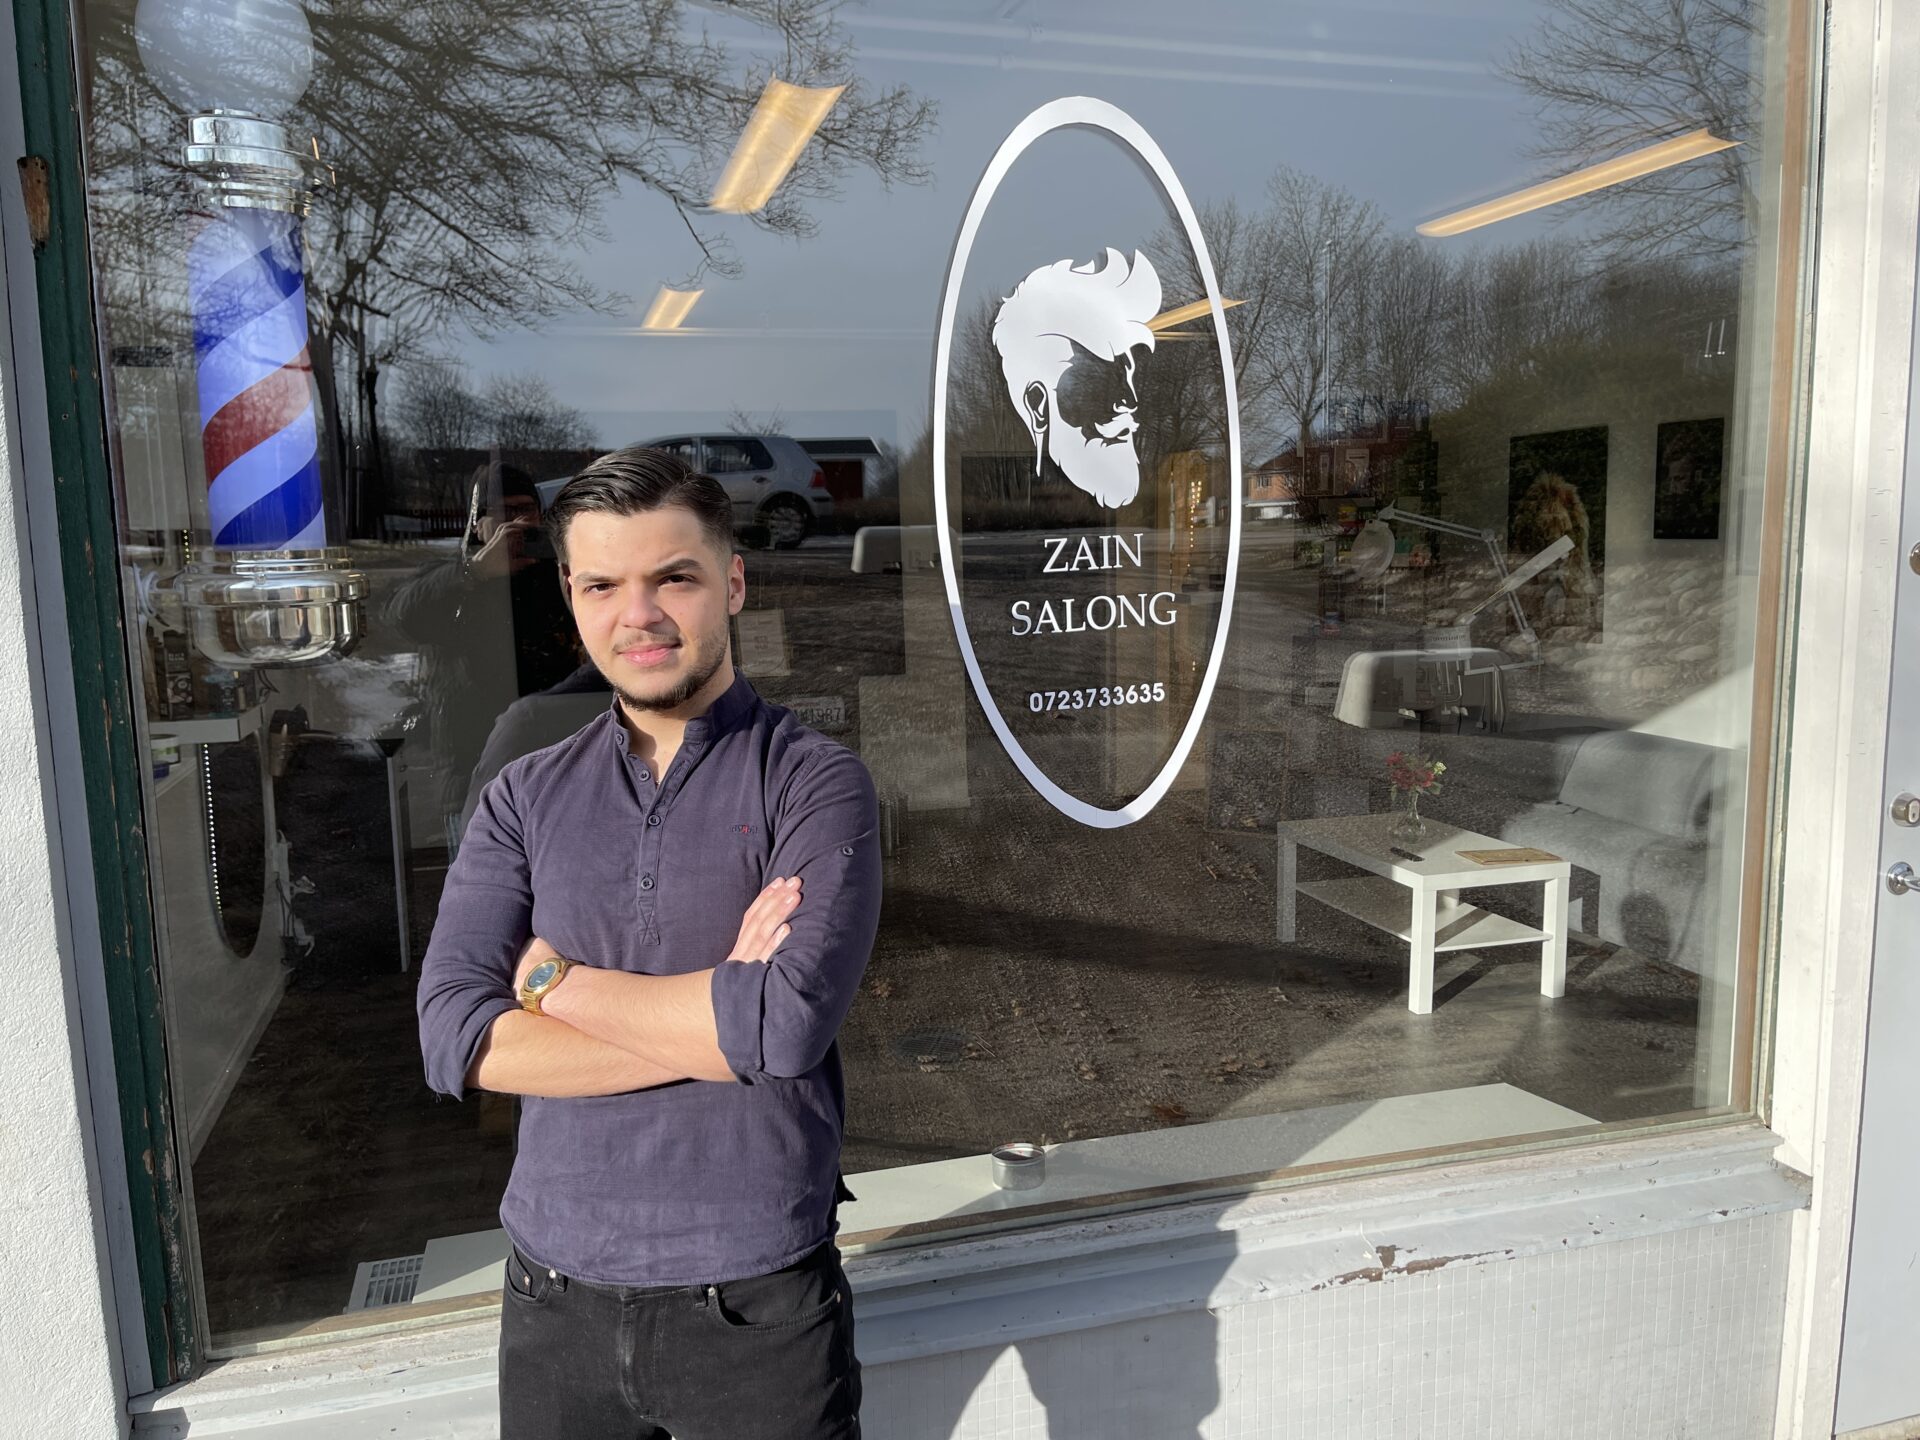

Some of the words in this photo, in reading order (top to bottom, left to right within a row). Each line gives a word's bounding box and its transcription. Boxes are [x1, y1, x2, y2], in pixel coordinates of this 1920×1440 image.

[1042, 533, 1144, 573] ZAIN
[1011, 591, 1178, 636] SALONG
[1029, 682, 1166, 713] 0723733635
